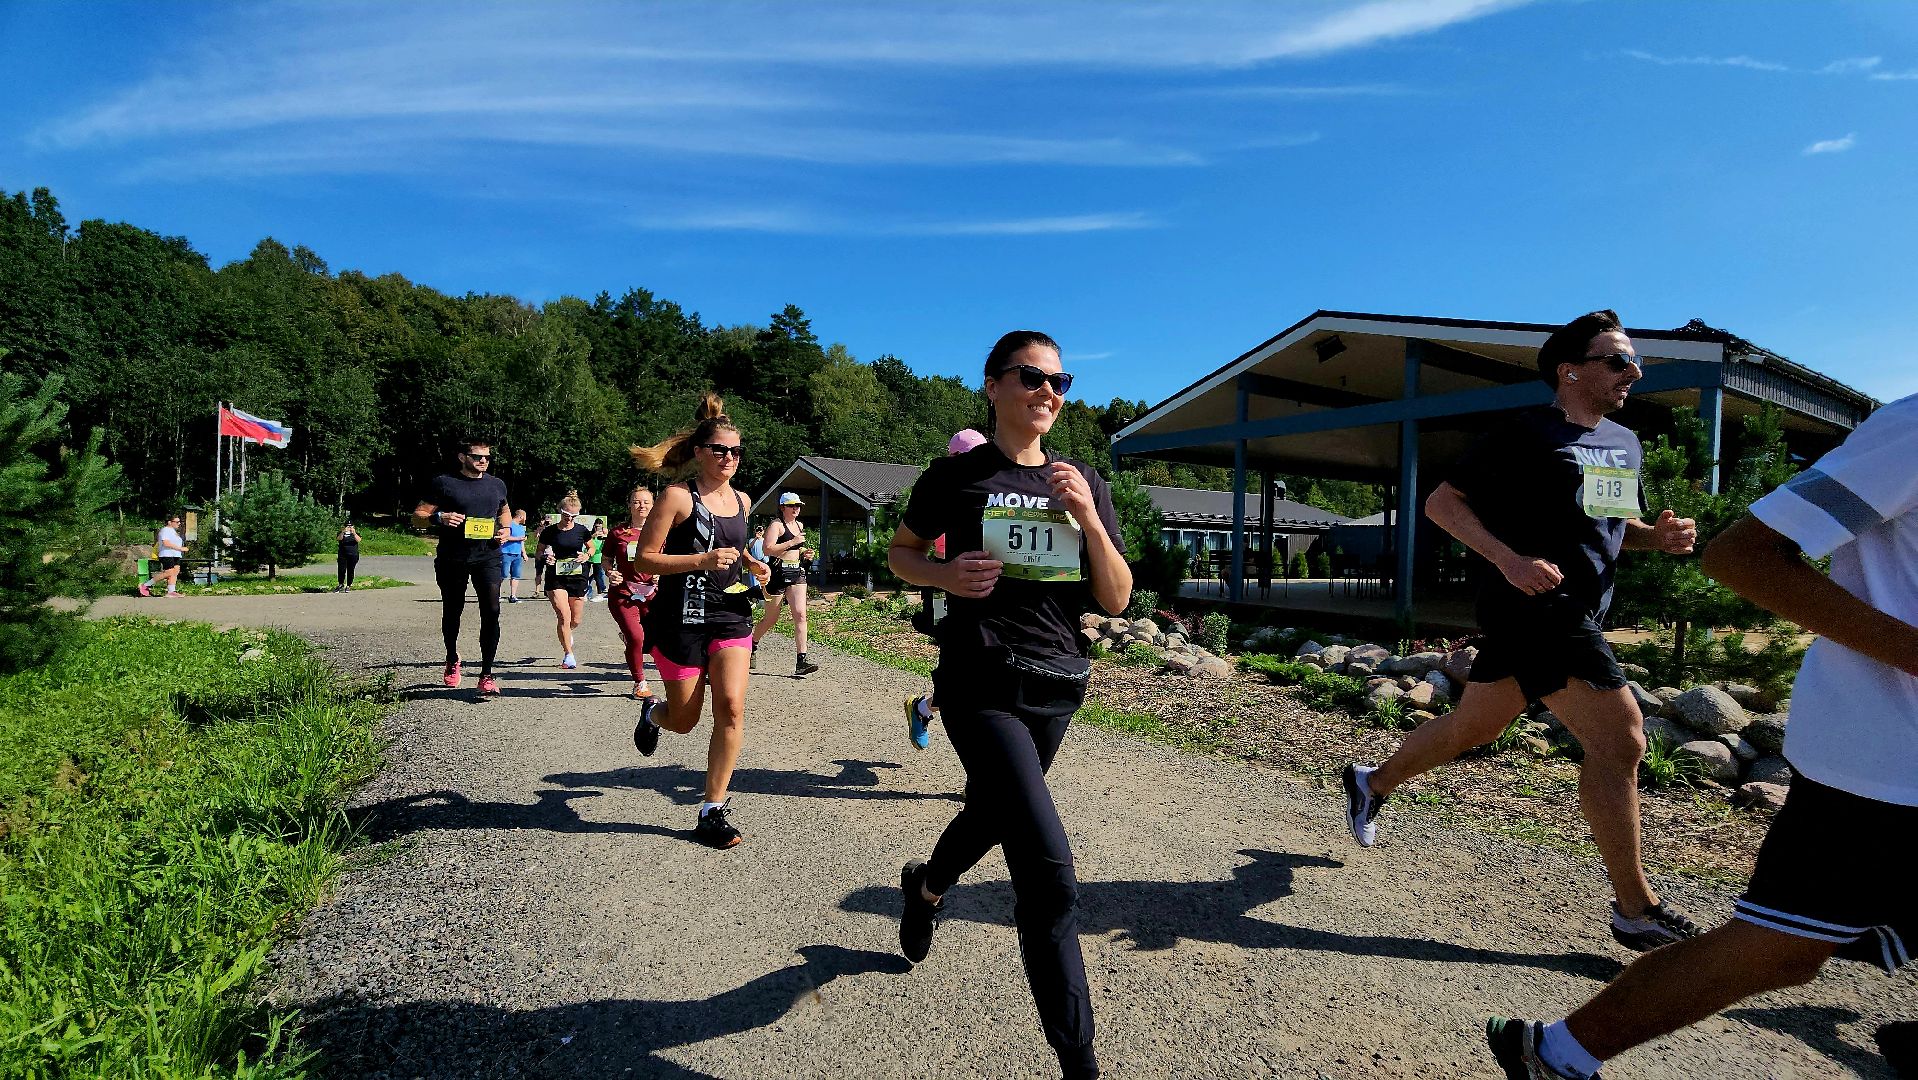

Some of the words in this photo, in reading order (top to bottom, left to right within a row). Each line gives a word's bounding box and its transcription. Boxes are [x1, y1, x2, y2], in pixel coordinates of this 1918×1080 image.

[1597, 478, 1622, 498] 513
[986, 492, 1050, 510] MOVE
[1008, 524, 1053, 551] 511
